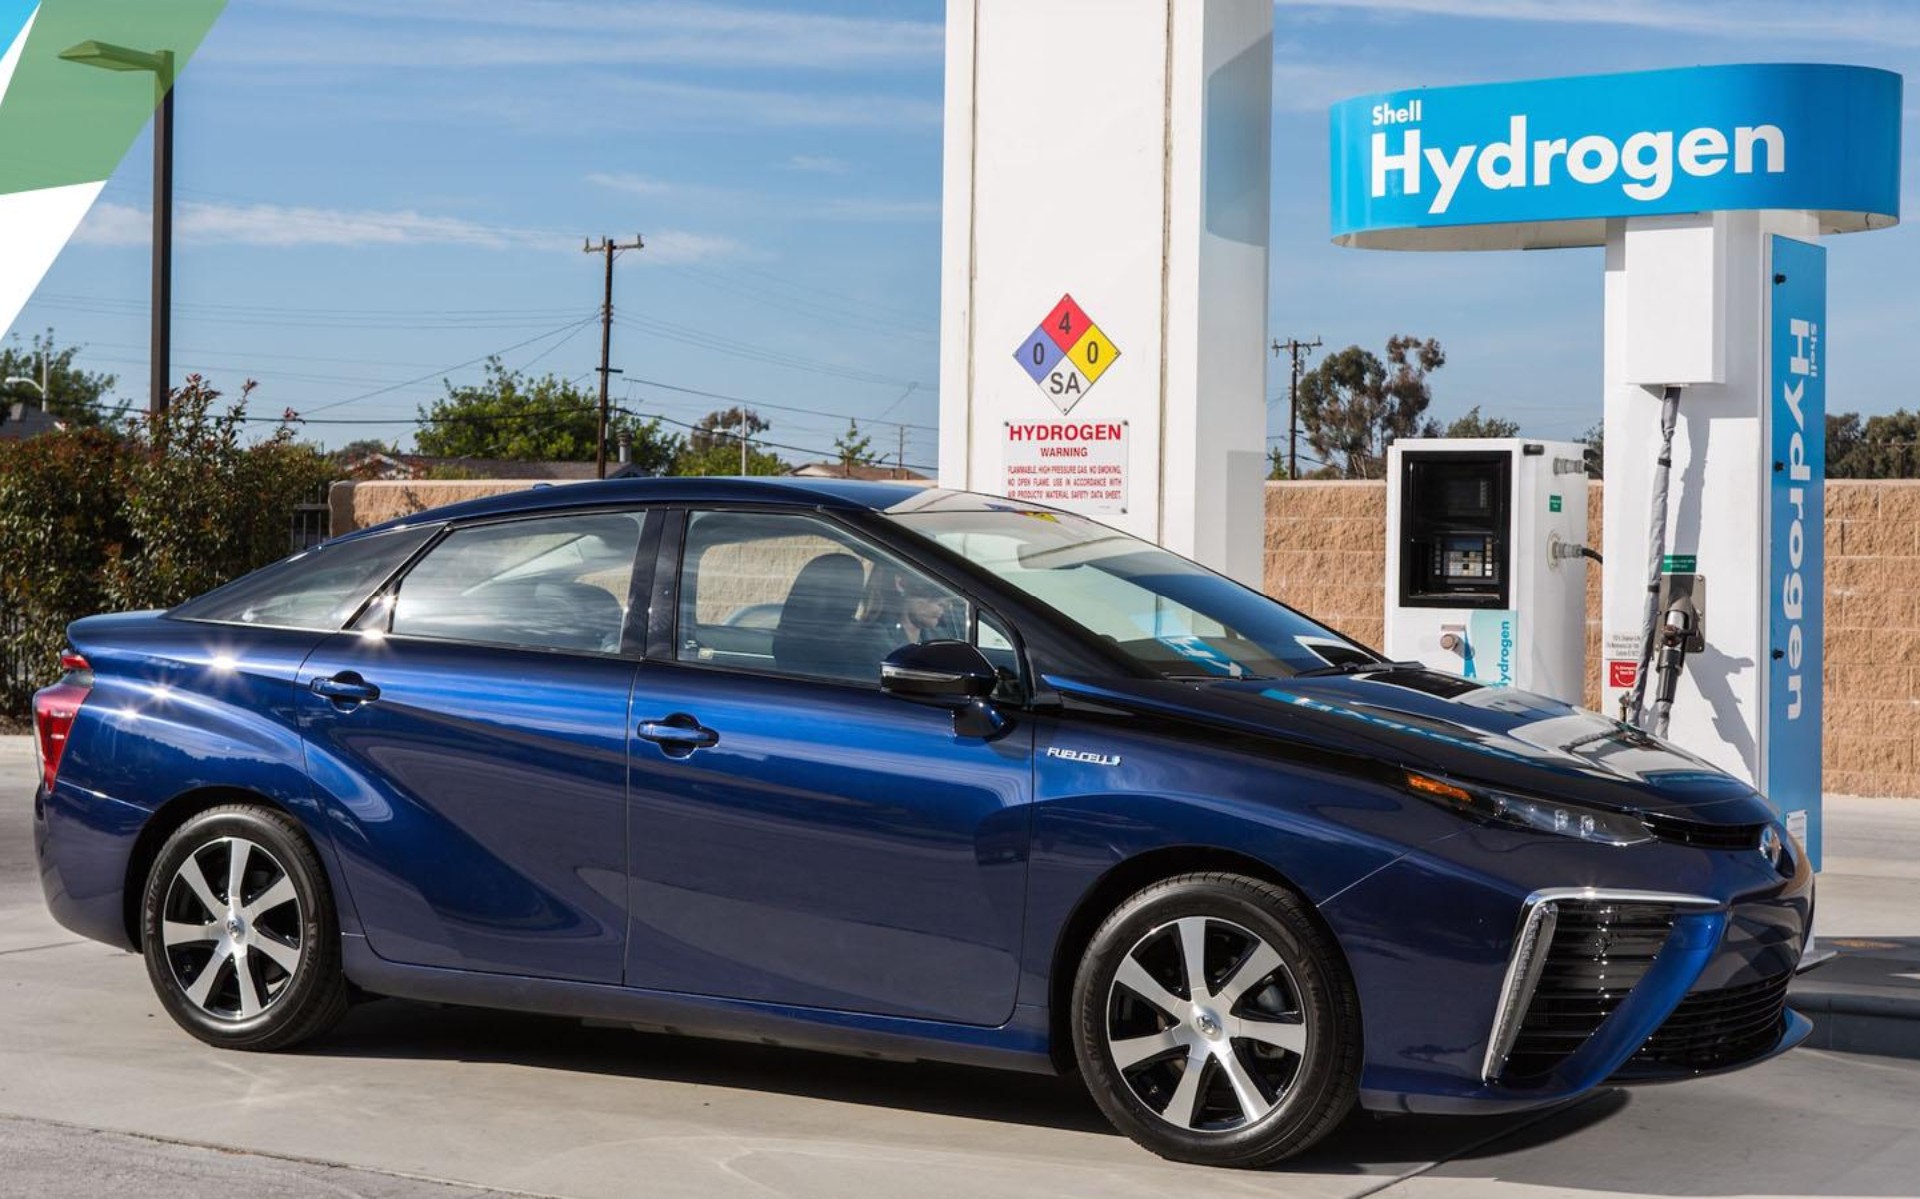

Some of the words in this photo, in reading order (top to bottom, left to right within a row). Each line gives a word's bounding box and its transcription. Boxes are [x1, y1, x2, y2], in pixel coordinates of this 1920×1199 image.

[1372, 100, 1422, 126] Shell
[1371, 115, 1785, 214] Hydrogen
[1058, 312, 1071, 334] 4
[1032, 342, 1045, 365] 0
[1086, 341, 1099, 364] 0
[1810, 322, 1818, 378] Shell
[1050, 372, 1081, 394] SA
[1009, 424, 1121, 441] HYDROGEN
[1040, 447, 1088, 457] WARNING
[1089, 465, 1097, 474] NO
[1008, 478, 1015, 487] NO
[1017, 478, 1031, 487] OPEN
[1053, 478, 1063, 487] USE
[1065, 478, 1071, 487] IN
[1073, 478, 1106, 487] ACCORDANCE
[1109, 478, 1122, 487] WITH
[1045, 490, 1069, 499] MATERIAL
[1071, 490, 1088, 499] SAFETY
[1090, 490, 1103, 499] DATA
[1784, 318, 1810, 720] Hydrogen
